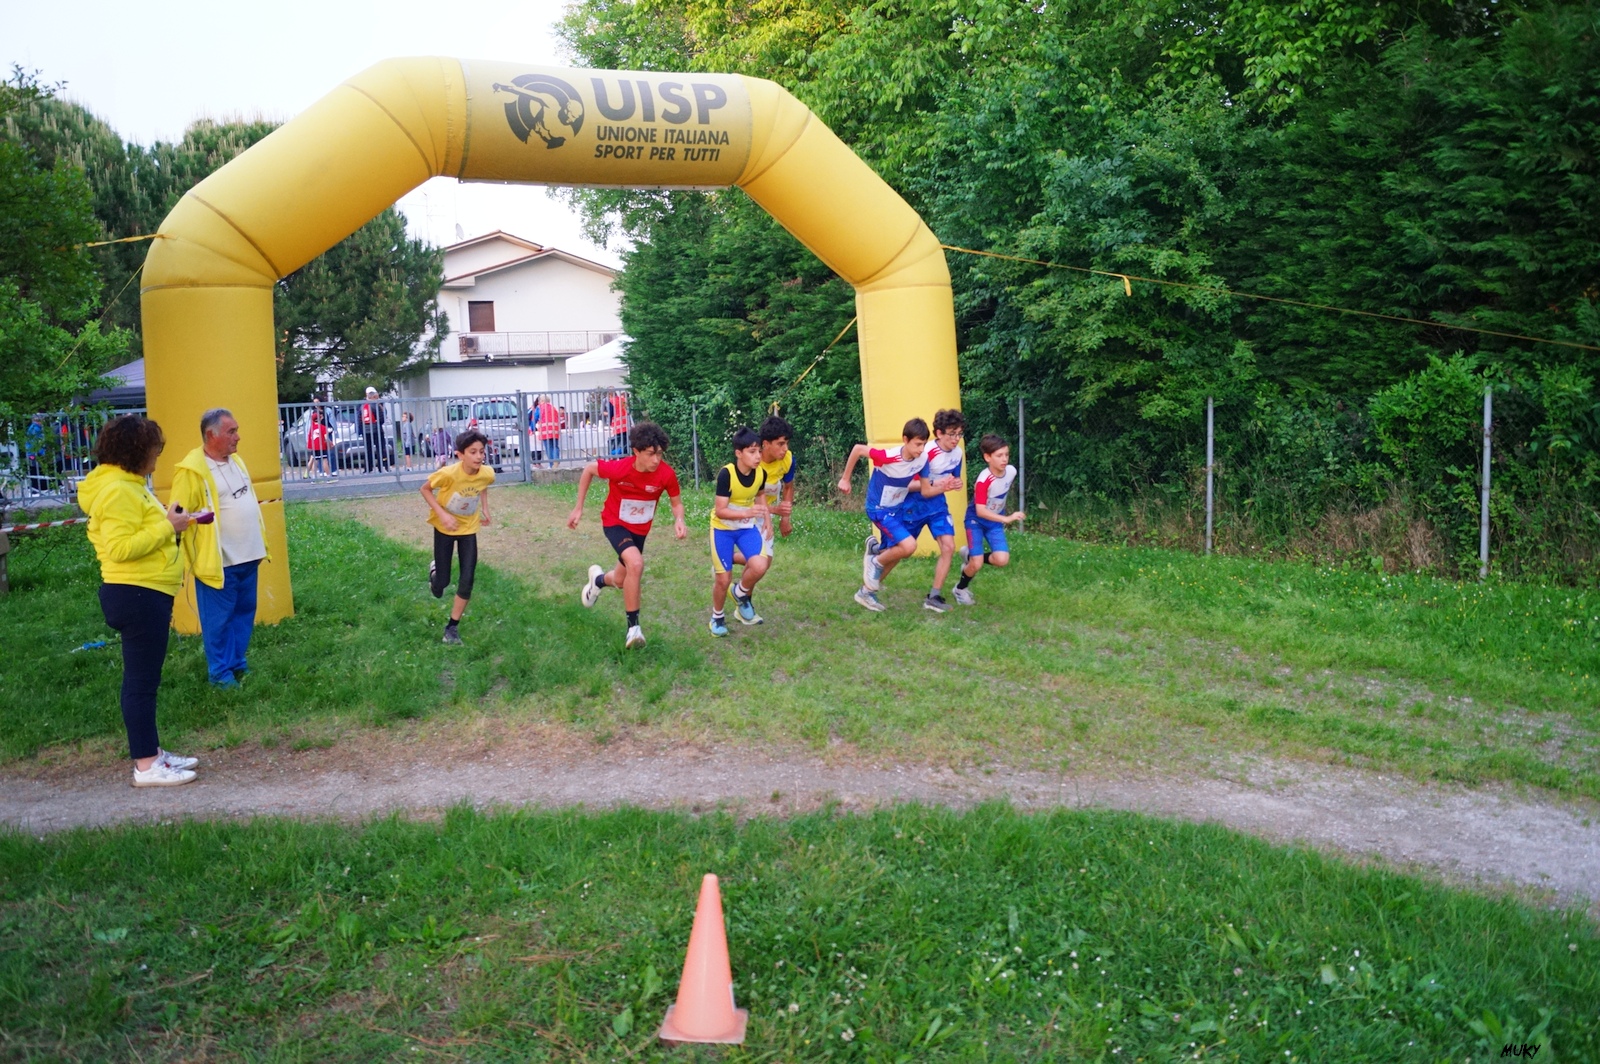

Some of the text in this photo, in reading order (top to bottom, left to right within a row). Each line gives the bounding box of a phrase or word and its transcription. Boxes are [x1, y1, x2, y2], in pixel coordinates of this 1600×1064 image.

[590, 77, 728, 125] UISP
[596, 125, 730, 146] UNIONE ITALIANA
[594, 143, 720, 162] SPORT PER TUTTI
[630, 506, 645, 516] 24
